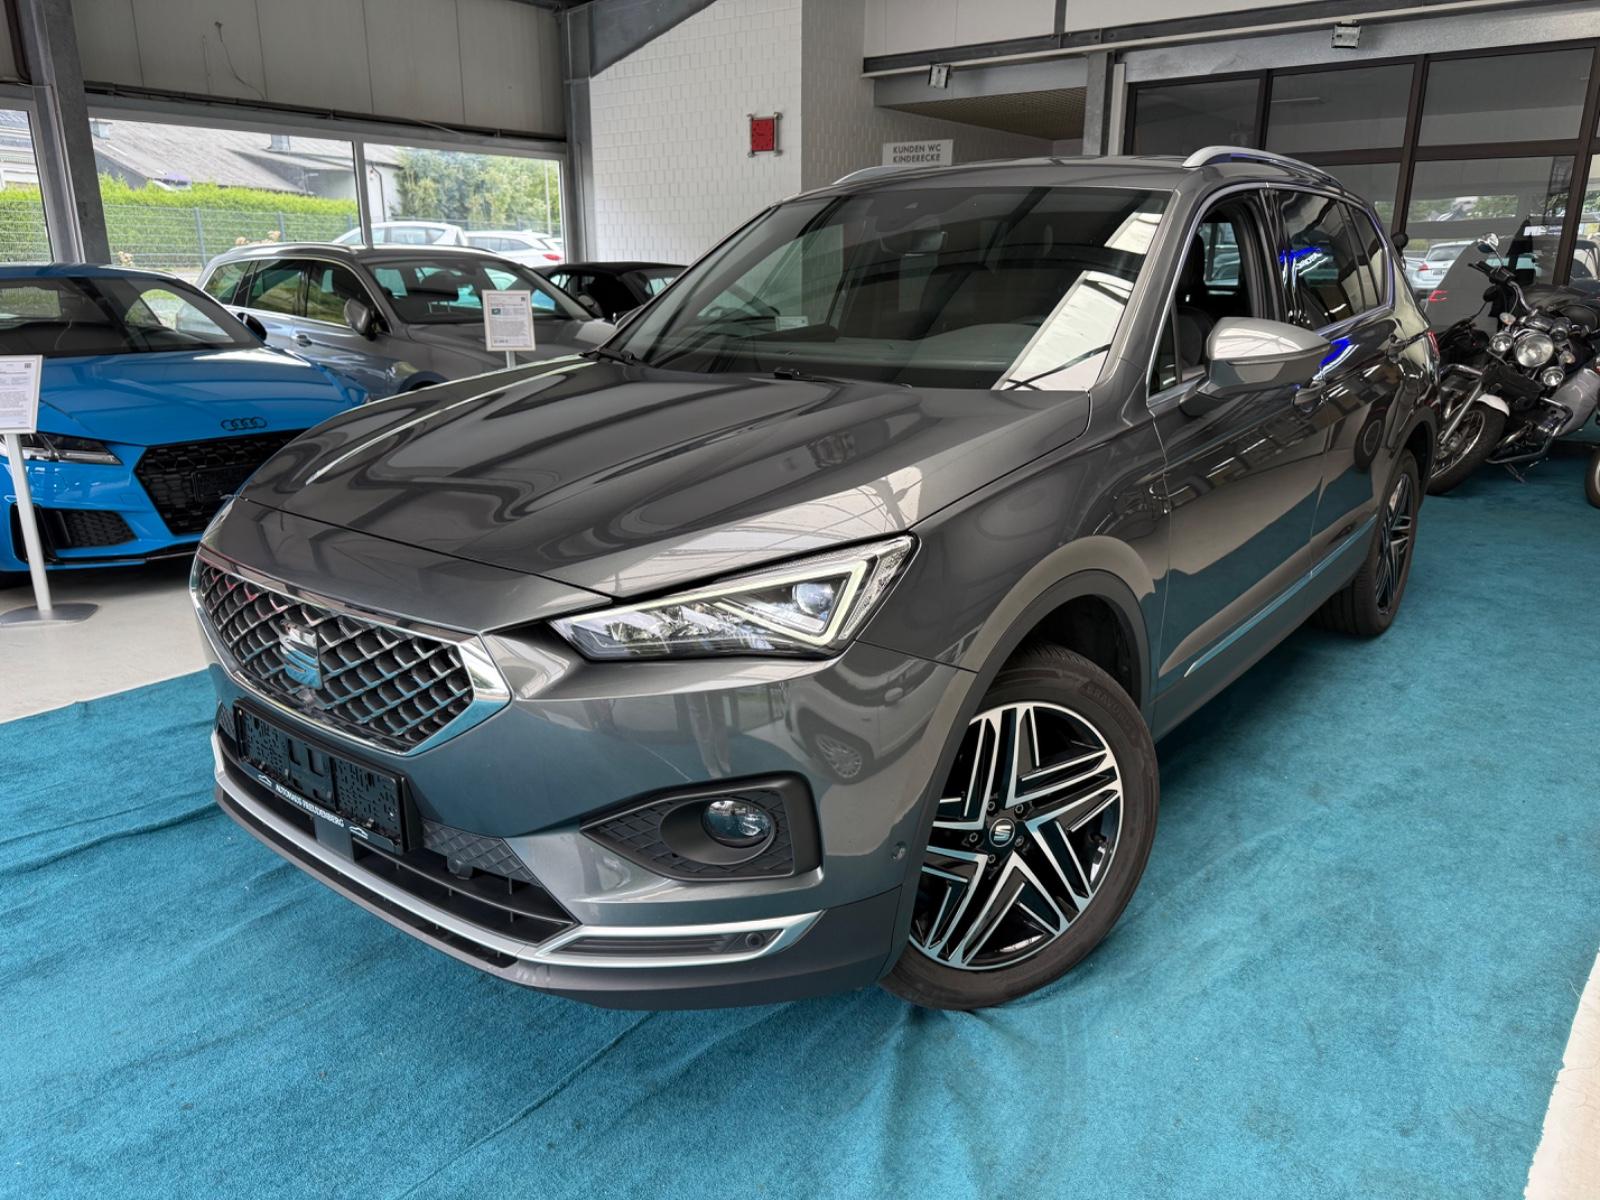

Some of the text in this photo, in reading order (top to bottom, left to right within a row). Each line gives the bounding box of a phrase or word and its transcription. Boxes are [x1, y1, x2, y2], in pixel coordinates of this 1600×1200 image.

[893, 144, 941, 153] KUNDEN WC
[893, 153, 941, 163] KINDERECKE
